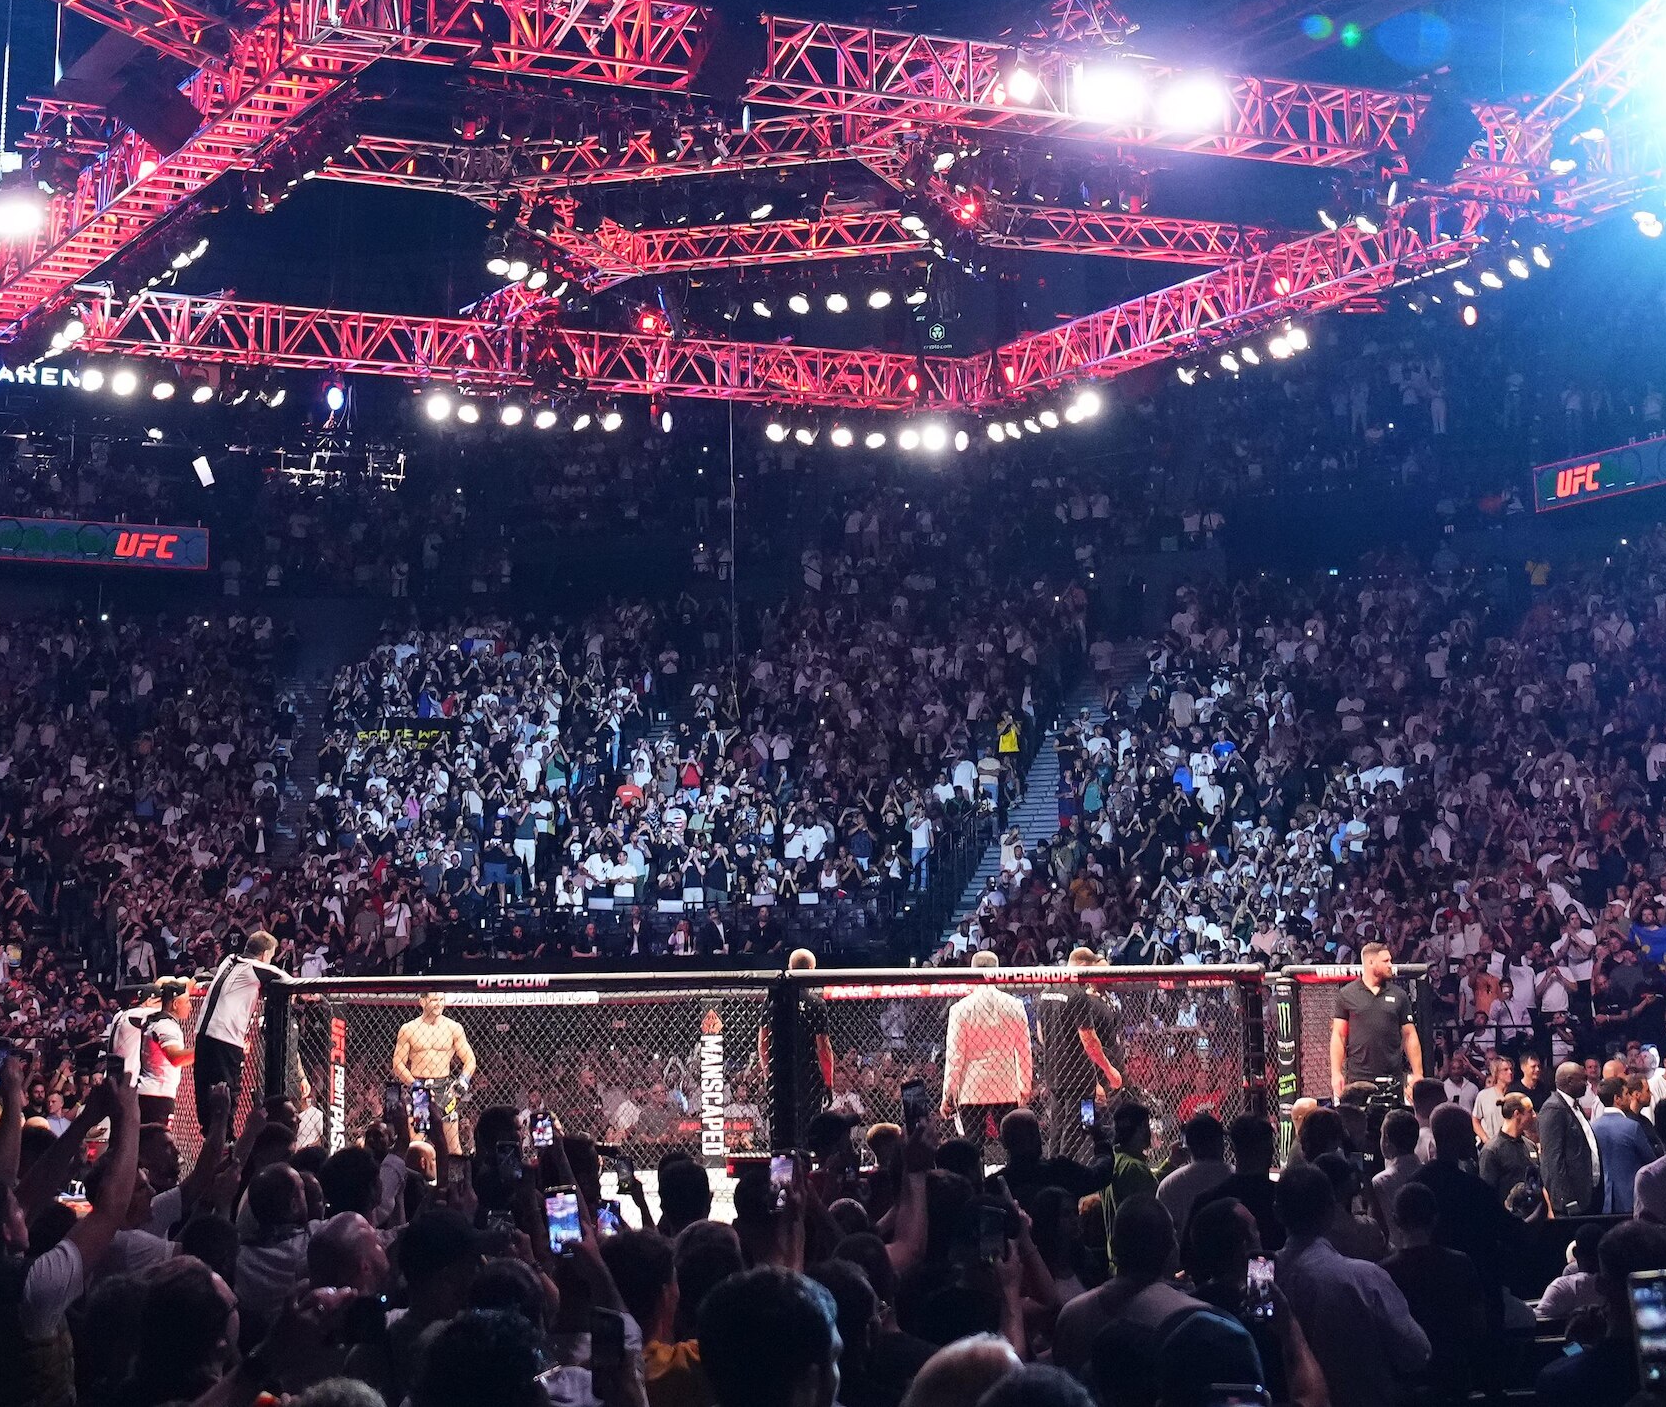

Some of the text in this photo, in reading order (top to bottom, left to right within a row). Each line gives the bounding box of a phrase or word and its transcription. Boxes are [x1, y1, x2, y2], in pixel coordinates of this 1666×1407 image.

[1556, 462, 1600, 498] UFC
[114, 532, 178, 560] UFC
[476, 976, 550, 989] UFC.COM
[982, 969, 1079, 982] @UFCEUROPE
[1315, 967, 1347, 978] VEGAS
[330, 1017, 346, 1064] UFC
[334, 1064, 345, 1105] FIGHT
[701, 1035, 724, 1155] MANSCAPED
